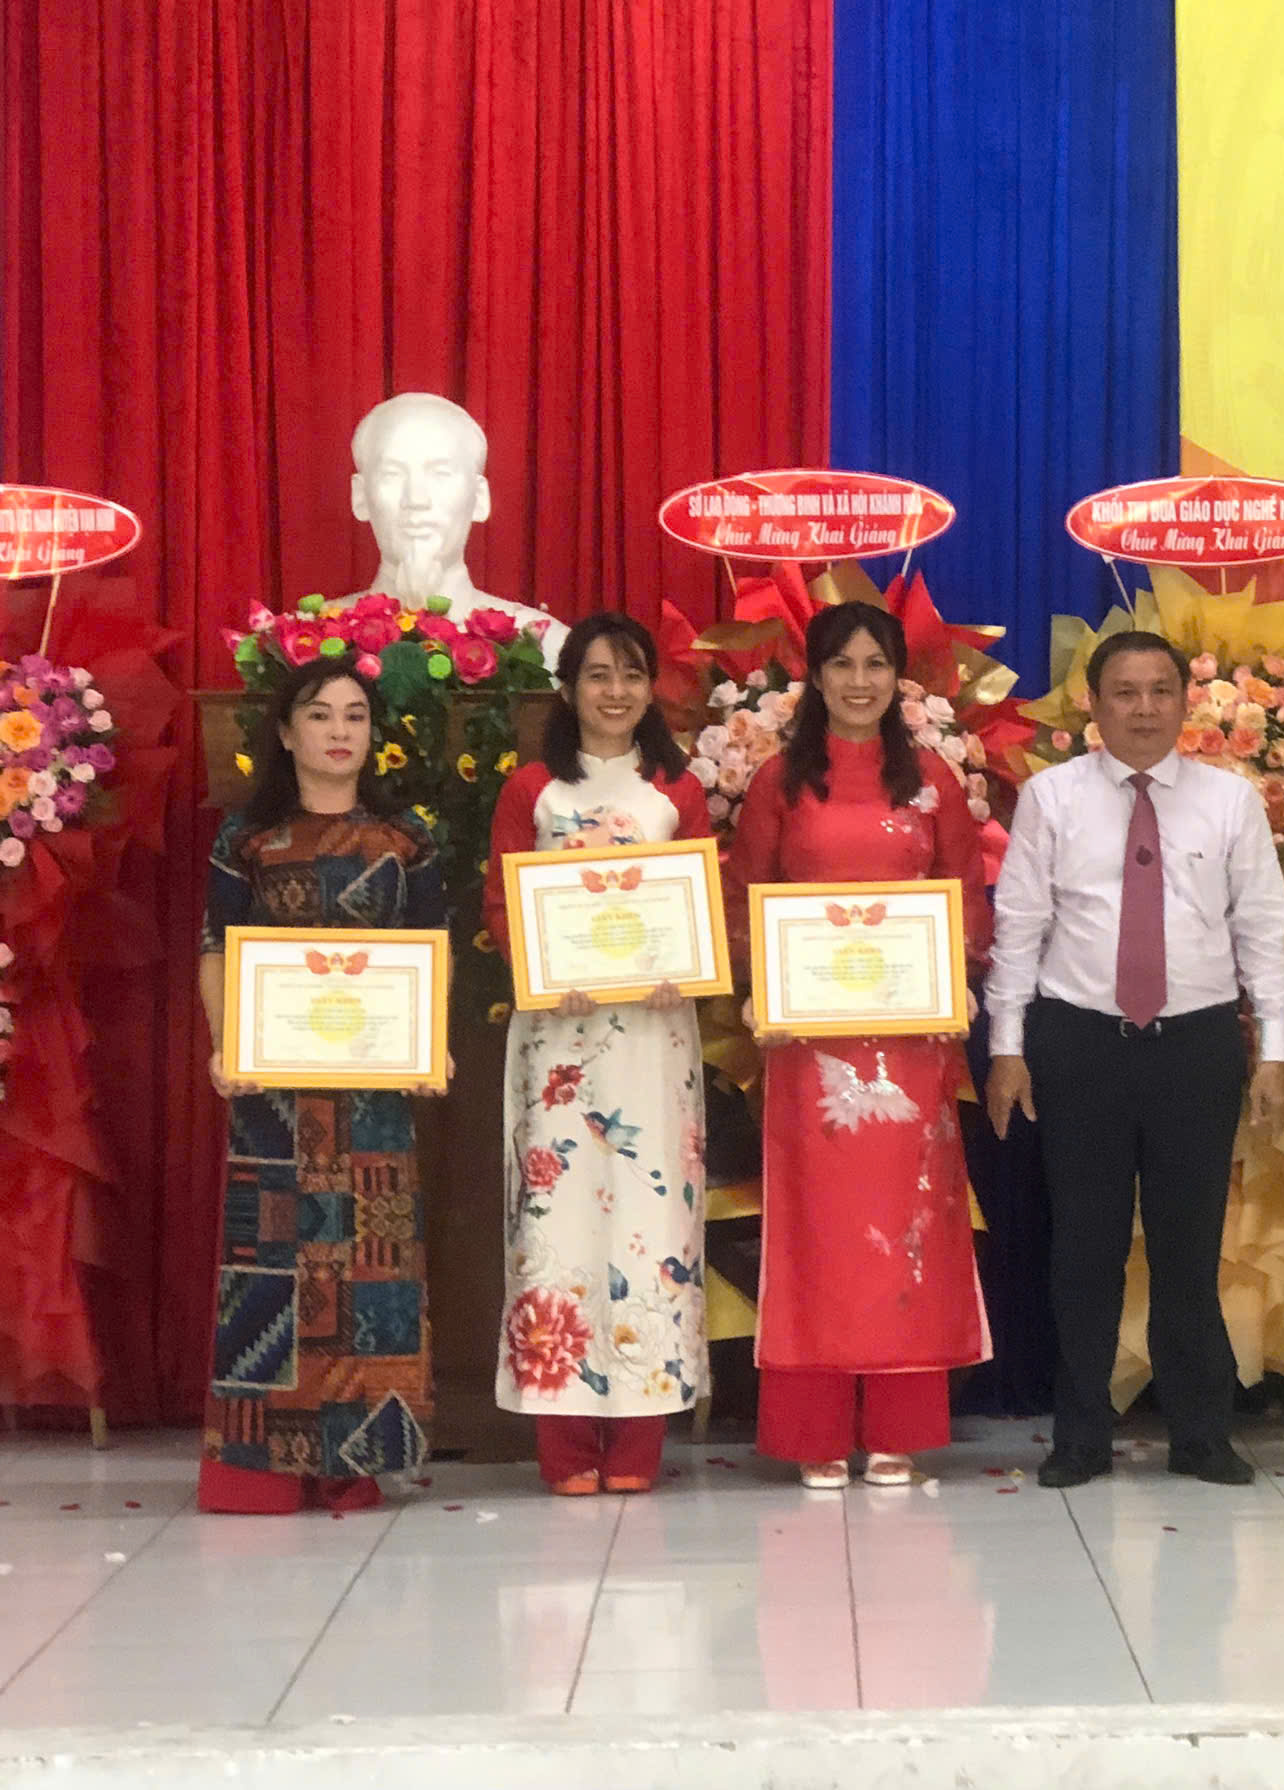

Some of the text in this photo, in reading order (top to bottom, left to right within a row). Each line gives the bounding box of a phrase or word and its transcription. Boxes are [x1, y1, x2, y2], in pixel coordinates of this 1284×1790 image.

[1180, 496, 1211, 522] GIÁO
[1214, 500, 1240, 527] DỤC
[807, 521, 844, 545] Khai
[1209, 527, 1249, 551] Khai
